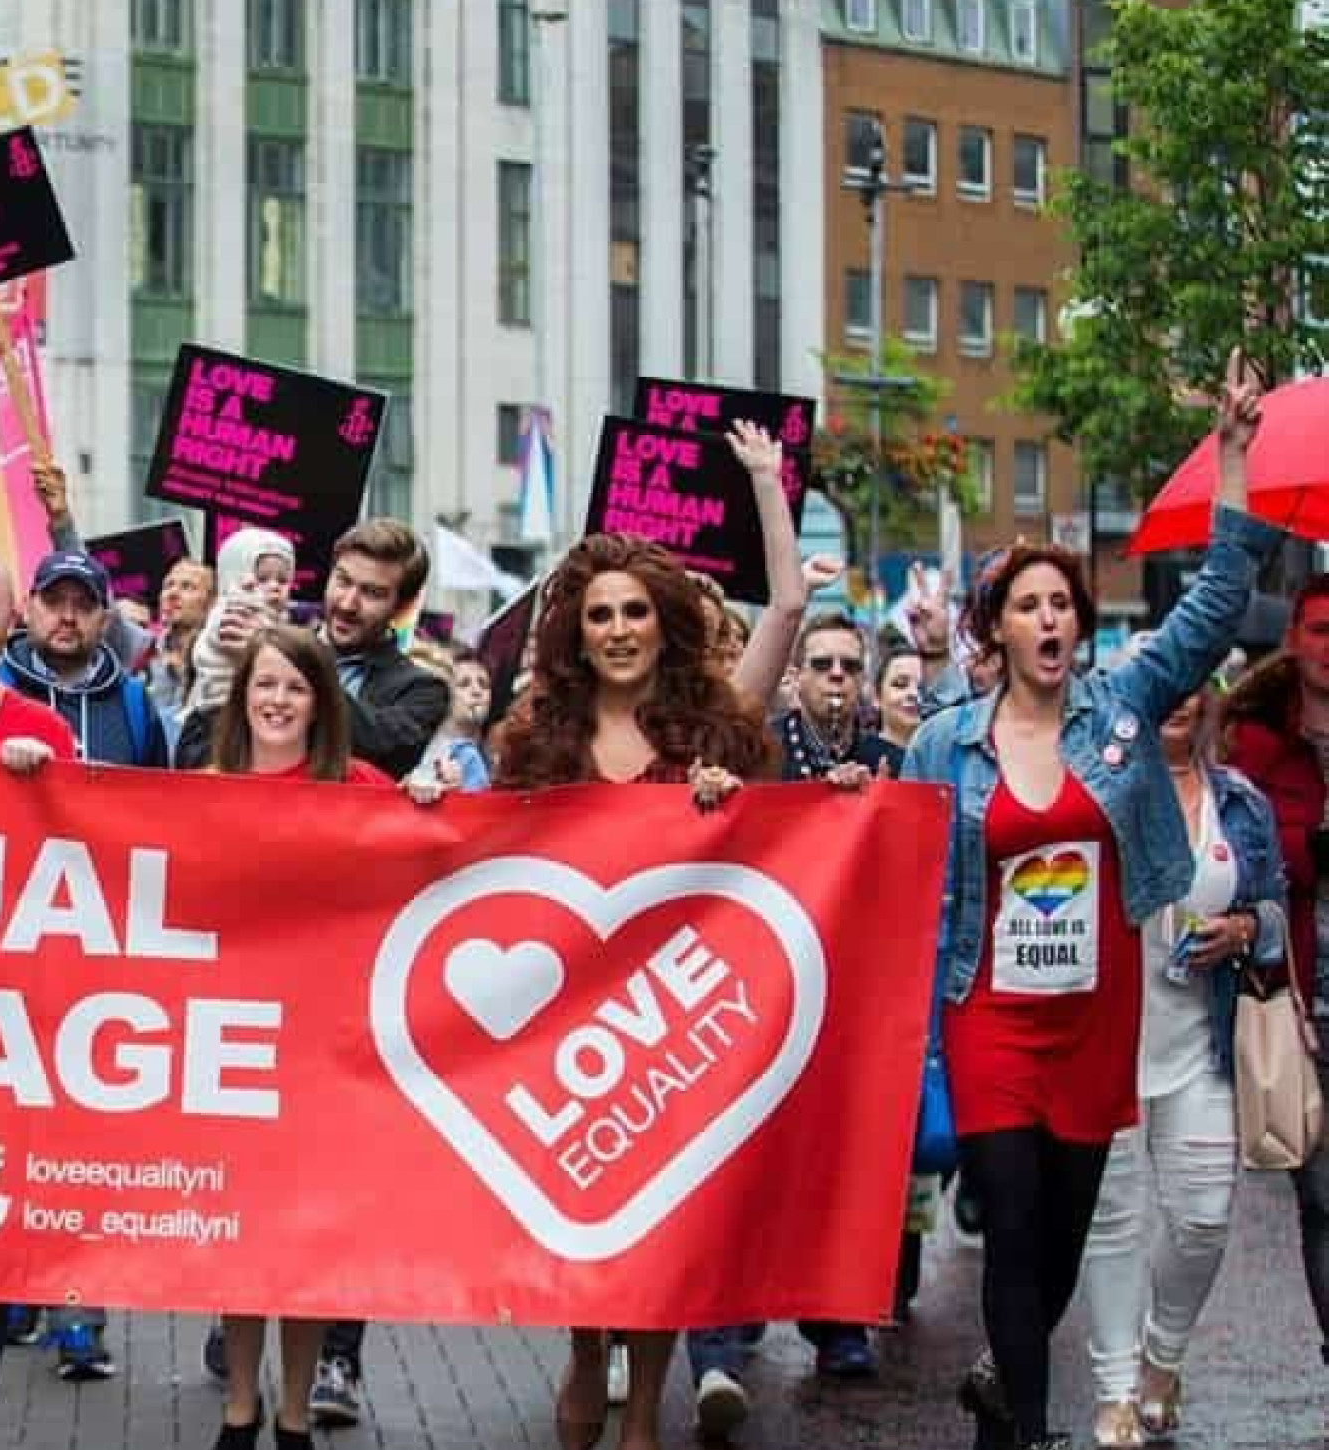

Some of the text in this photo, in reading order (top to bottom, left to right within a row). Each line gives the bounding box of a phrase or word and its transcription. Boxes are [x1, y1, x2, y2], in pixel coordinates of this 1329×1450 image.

[188, 357, 275, 402] LOVE
[647, 385, 721, 417] LOVE
[185, 387, 243, 419] IS A
[174, 434, 268, 480] RIGHT
[180, 411, 296, 461] HUMAN
[616, 430, 703, 468] LOVE
[613, 457, 670, 487] IS A
[609, 482, 725, 526] HUMAN
[604, 508, 701, 547] RIGHT
[1016, 943, 1078, 968] EQUAL
[504, 924, 729, 1148] LOVE
[557, 981, 761, 1190] EQUALITY
[25, 1150, 225, 1198] loveequalityni
[23, 1199, 240, 1246] love_equalityni
